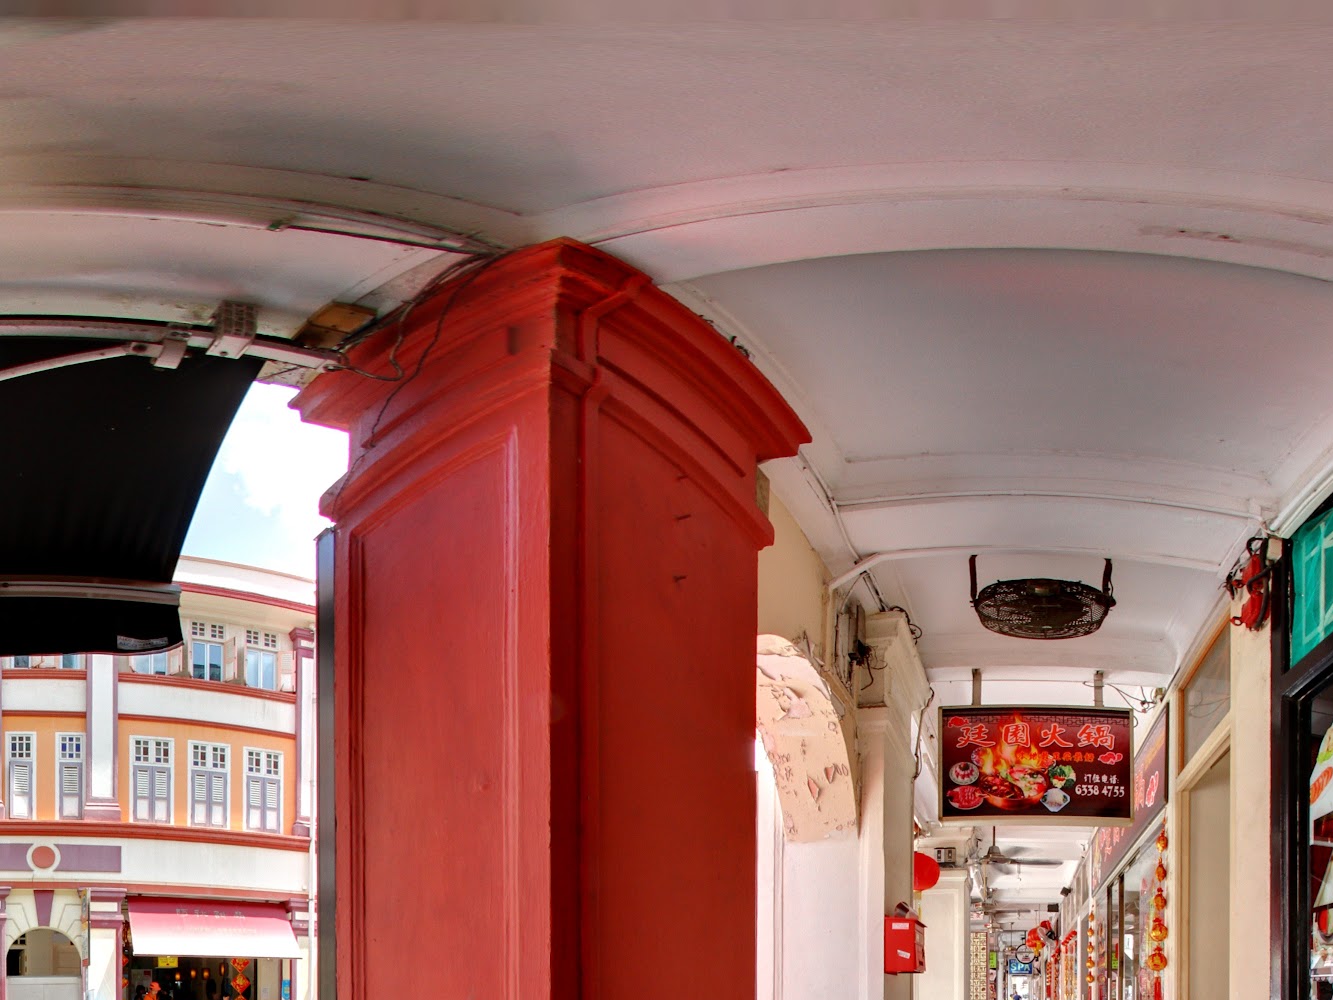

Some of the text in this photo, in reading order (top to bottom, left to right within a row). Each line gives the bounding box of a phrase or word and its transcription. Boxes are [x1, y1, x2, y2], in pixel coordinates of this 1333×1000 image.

[1075, 784, 1125, 798] 6338 4755
[1010, 963, 1030, 971] SPA
